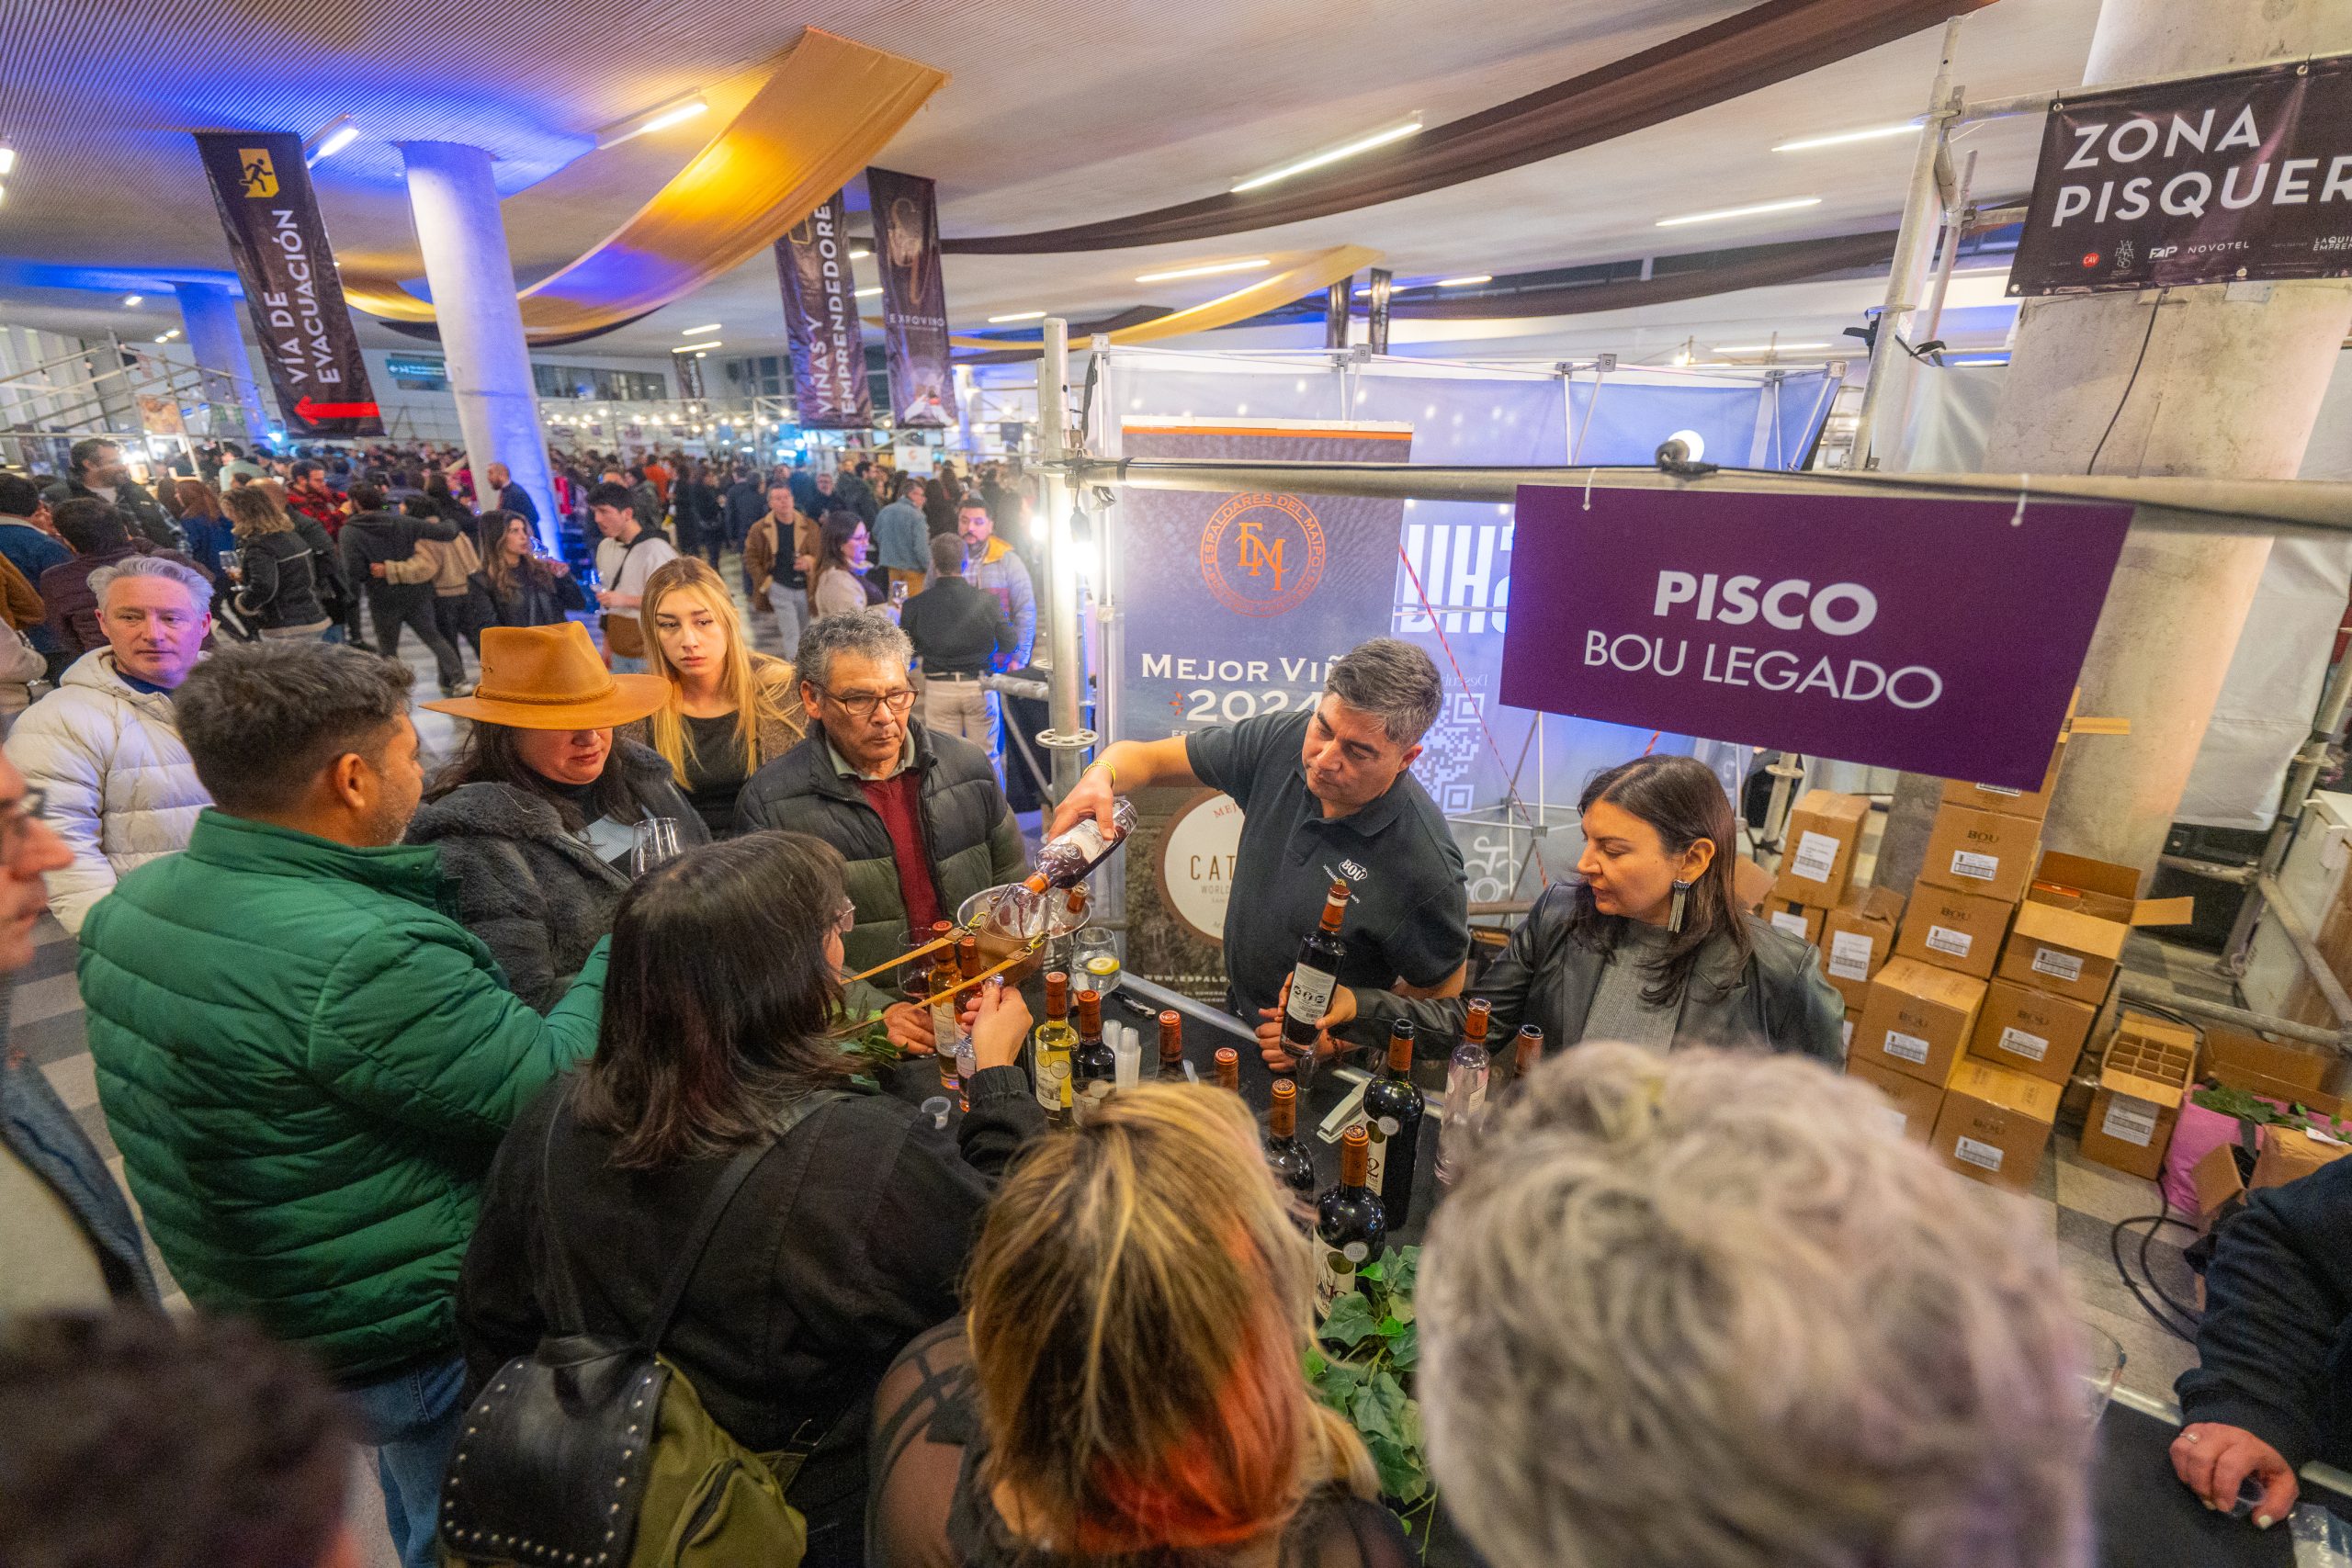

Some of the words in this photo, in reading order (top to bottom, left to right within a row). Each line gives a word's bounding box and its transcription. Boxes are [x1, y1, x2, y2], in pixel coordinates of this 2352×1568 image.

[2064, 103, 2261, 171] ZONA
[2052, 154, 2352, 228] PISQUER
[2083, 256, 2099, 265] CAV
[2188, 241, 2250, 254] NOVOTEL
[263, 291, 296, 328] DE
[271, 209, 342, 384] EVACUACIÓN
[805, 314, 824, 332] Y
[813, 199, 858, 414] EMPRENDEDORE
[277, 336, 310, 385] VÍA
[809, 341, 833, 414] VIÑAS
[1204, 493, 1273, 564] ESPALDARES
[1276, 495, 1305, 519] DEL
[1303, 517, 1322, 567] MAIPO
[1653, 570, 1879, 637] PISCO
[1584, 629, 1688, 677] BOU
[1702, 644, 1943, 710] LEGADO
